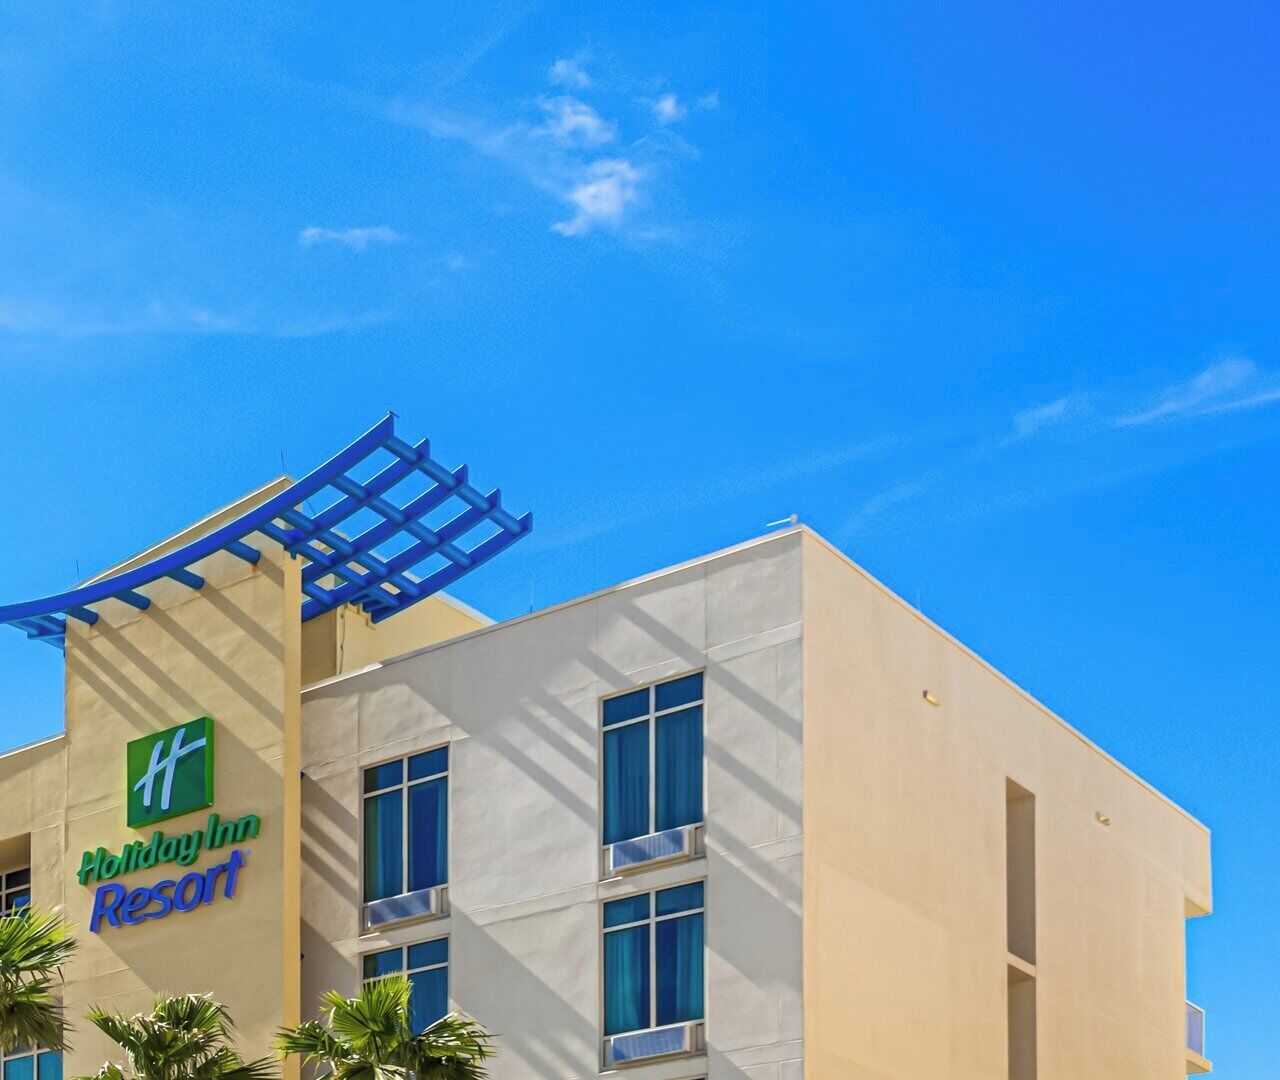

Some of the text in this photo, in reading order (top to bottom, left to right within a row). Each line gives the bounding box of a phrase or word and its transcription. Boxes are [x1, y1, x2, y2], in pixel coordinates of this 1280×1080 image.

[134, 727, 206, 810] H
[77, 813, 261, 886] Holiday Inn
[90, 850, 245, 934] Resort
